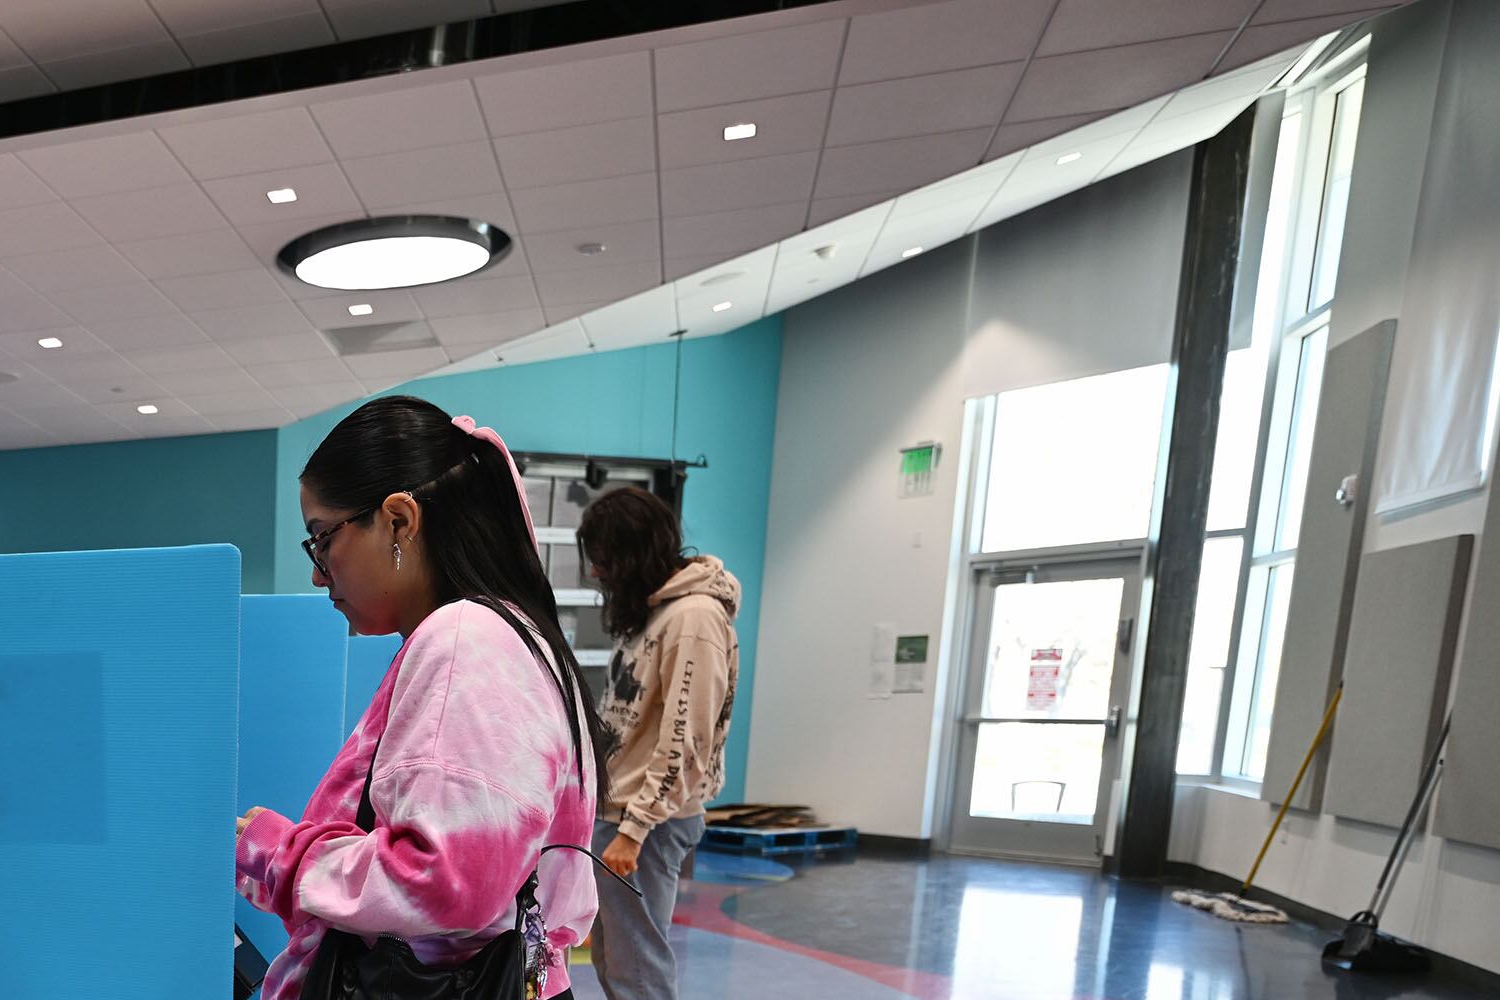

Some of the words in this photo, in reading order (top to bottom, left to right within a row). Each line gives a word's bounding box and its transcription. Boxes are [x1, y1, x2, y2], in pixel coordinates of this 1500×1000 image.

[681, 660, 694, 695] LIFE
[677, 698, 688, 715] IS
[672, 719, 687, 745] BUT
[668, 749, 681, 760] A
